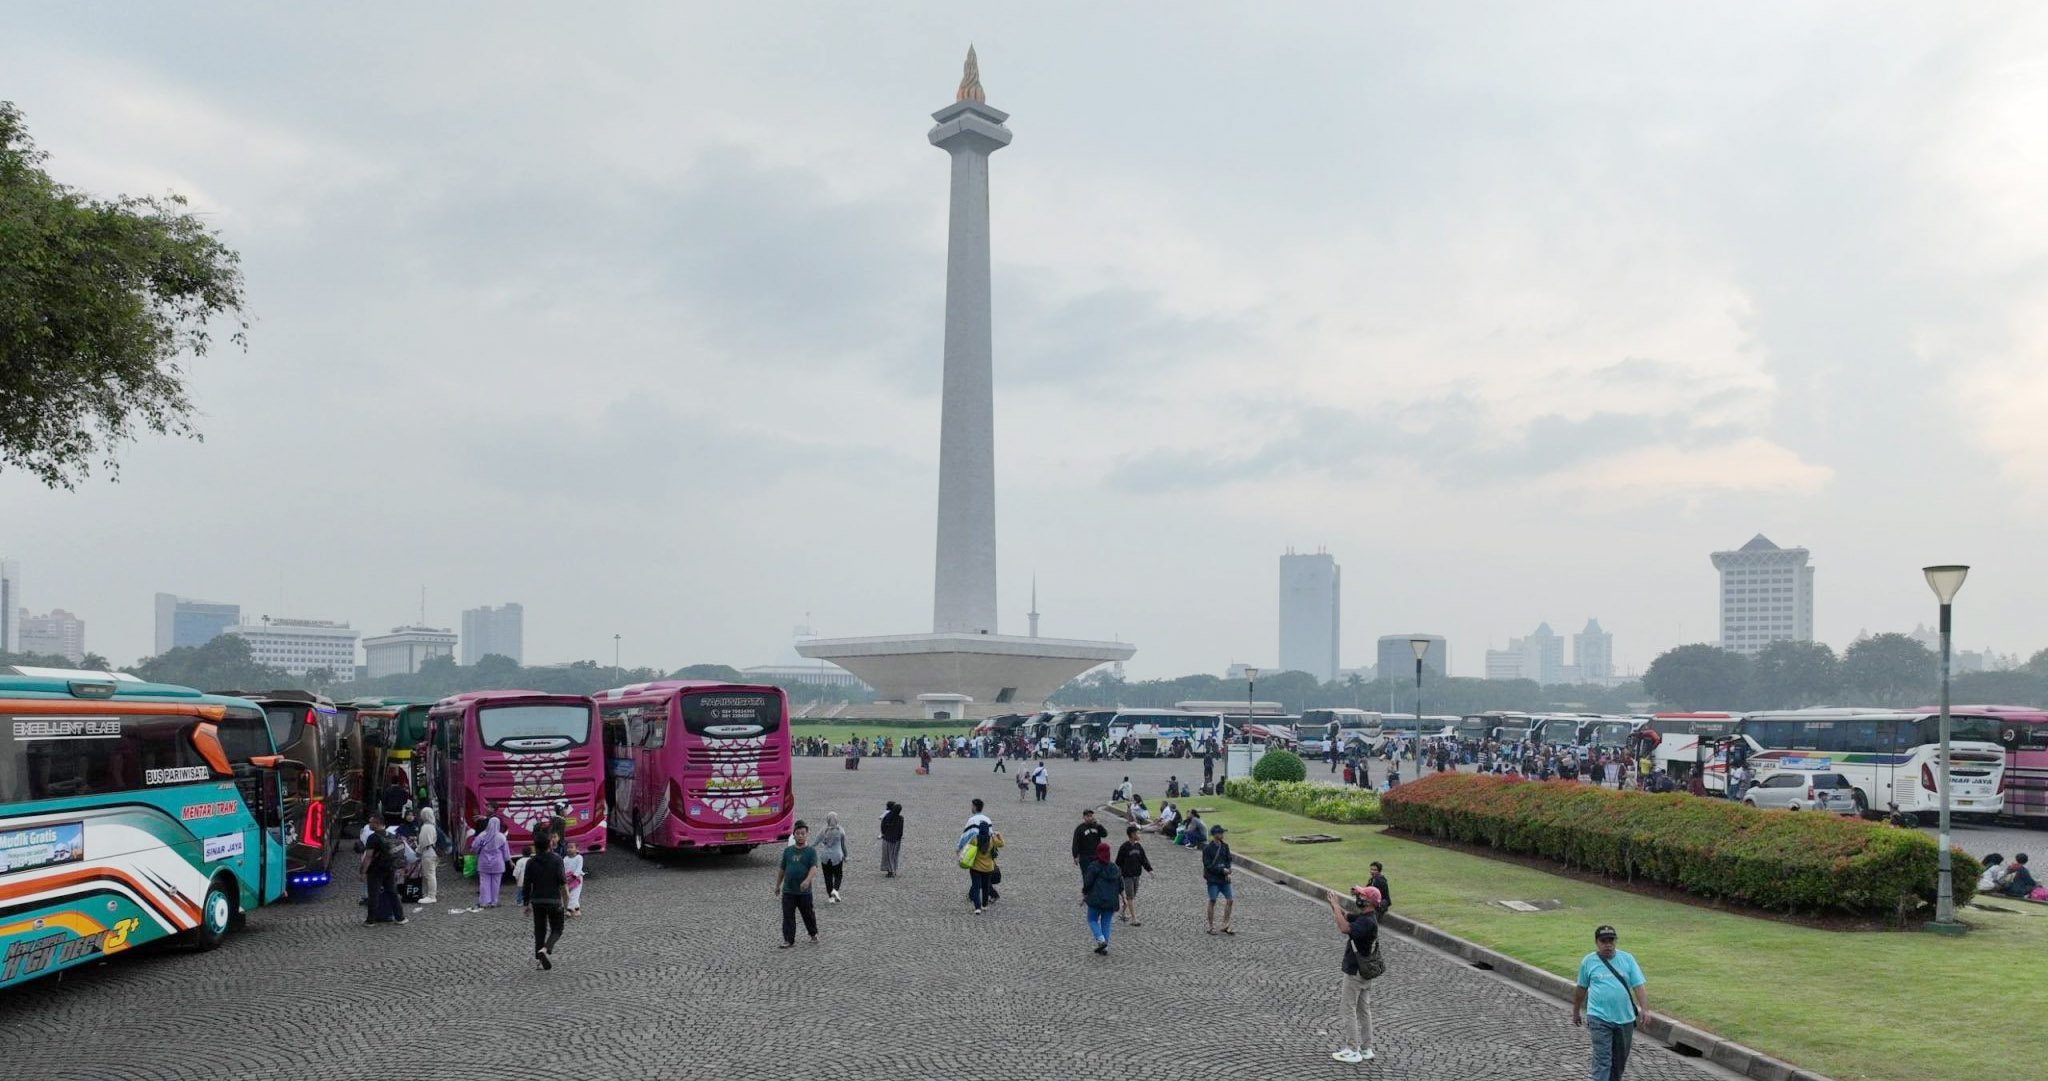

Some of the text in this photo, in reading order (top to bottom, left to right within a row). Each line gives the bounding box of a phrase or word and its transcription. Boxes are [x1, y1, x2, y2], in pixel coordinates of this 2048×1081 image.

[13, 721, 120, 735] EXCELLENT CLASS
[146, 766, 209, 784] BUS PARIWISATA
[182, 800, 238, 820] MENTARI TRANS
[30, 829, 57, 844] Gratis
[206, 842, 242, 857] SINAR JAYA
